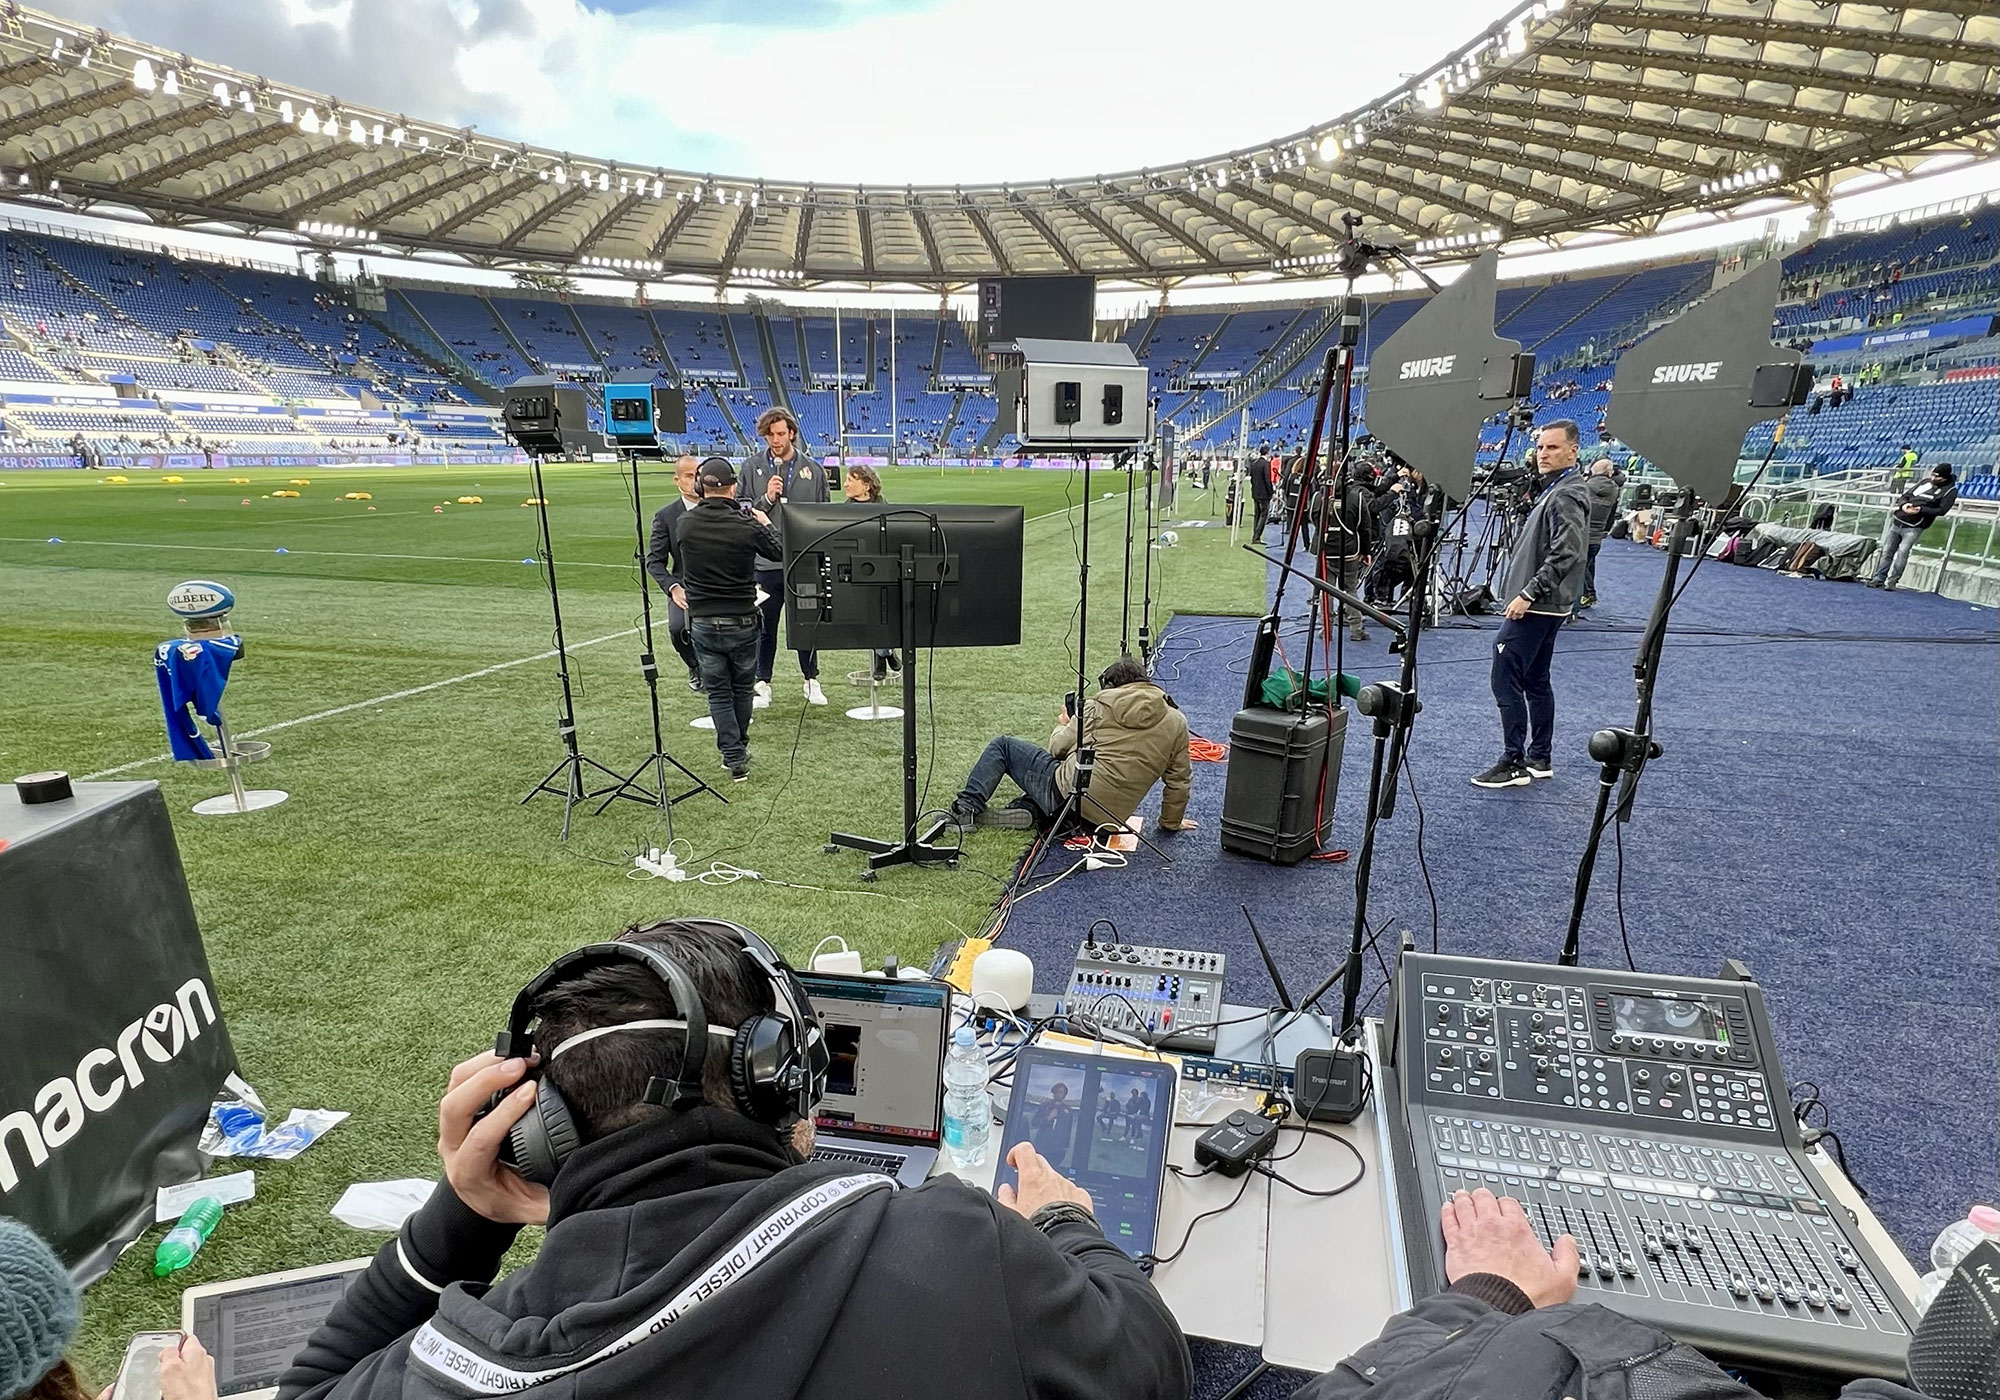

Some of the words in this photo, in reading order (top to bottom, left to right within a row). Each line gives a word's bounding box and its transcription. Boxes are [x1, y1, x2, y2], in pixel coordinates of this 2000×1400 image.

[1399, 354, 1456, 380] SHURE
[1651, 361, 1722, 384] SHURE
[20, 456, 81, 468] COSTRUIRE
[751, 1192, 828, 1254] COPYRIGHT
[689, 1252, 746, 1302] DIESEL
[649, 1308, 680, 1335] IND
[443, 1349, 477, 1379] DIESEL
